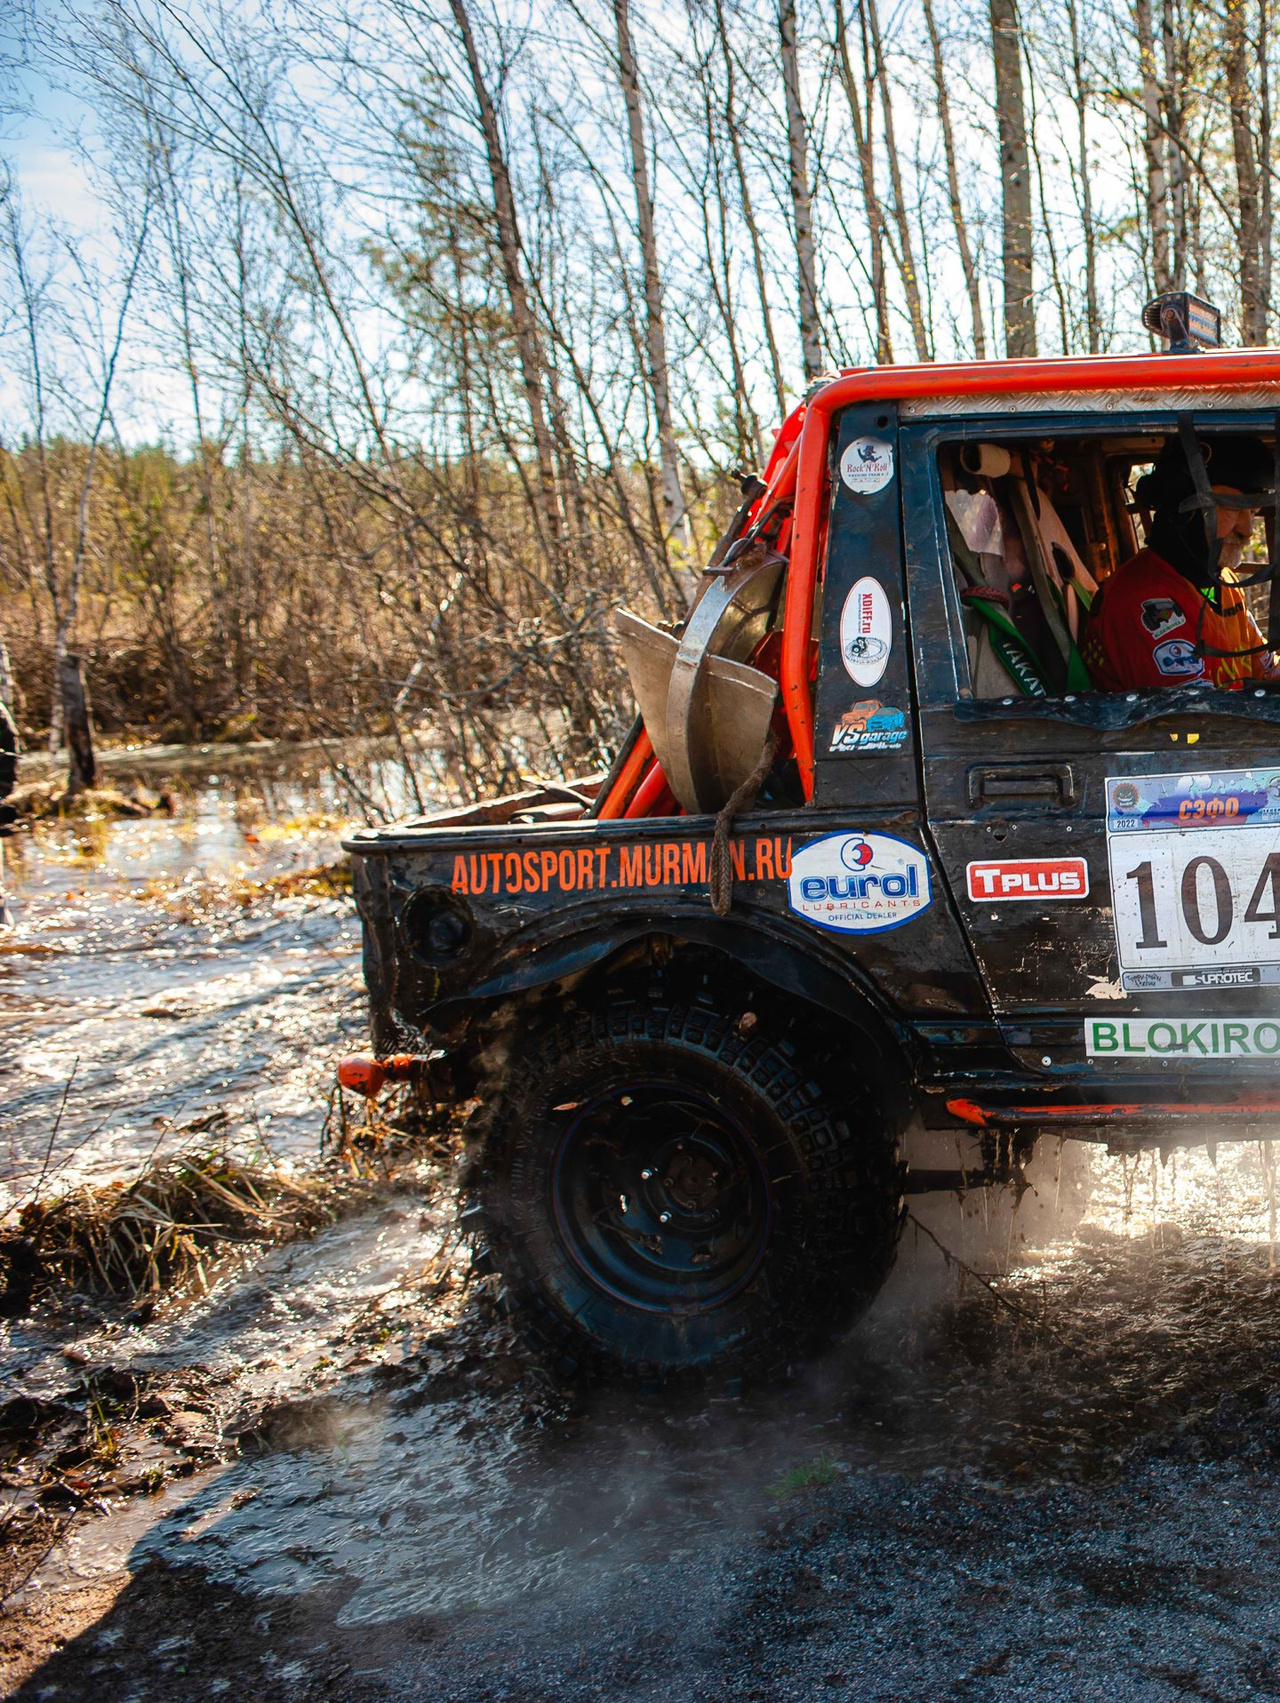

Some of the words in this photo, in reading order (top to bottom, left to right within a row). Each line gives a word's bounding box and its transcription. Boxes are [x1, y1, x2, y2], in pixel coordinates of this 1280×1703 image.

[832, 724, 864, 745] VS
[860, 730, 908, 744] garage
[1179, 797, 1239, 820] СЗФО
[1117, 820, 1136, 828] 2022
[800, 864, 919, 902] eurol
[802, 900, 921, 911] LUBRICANTS
[1195, 972, 1253, 985] SUPROTEC
